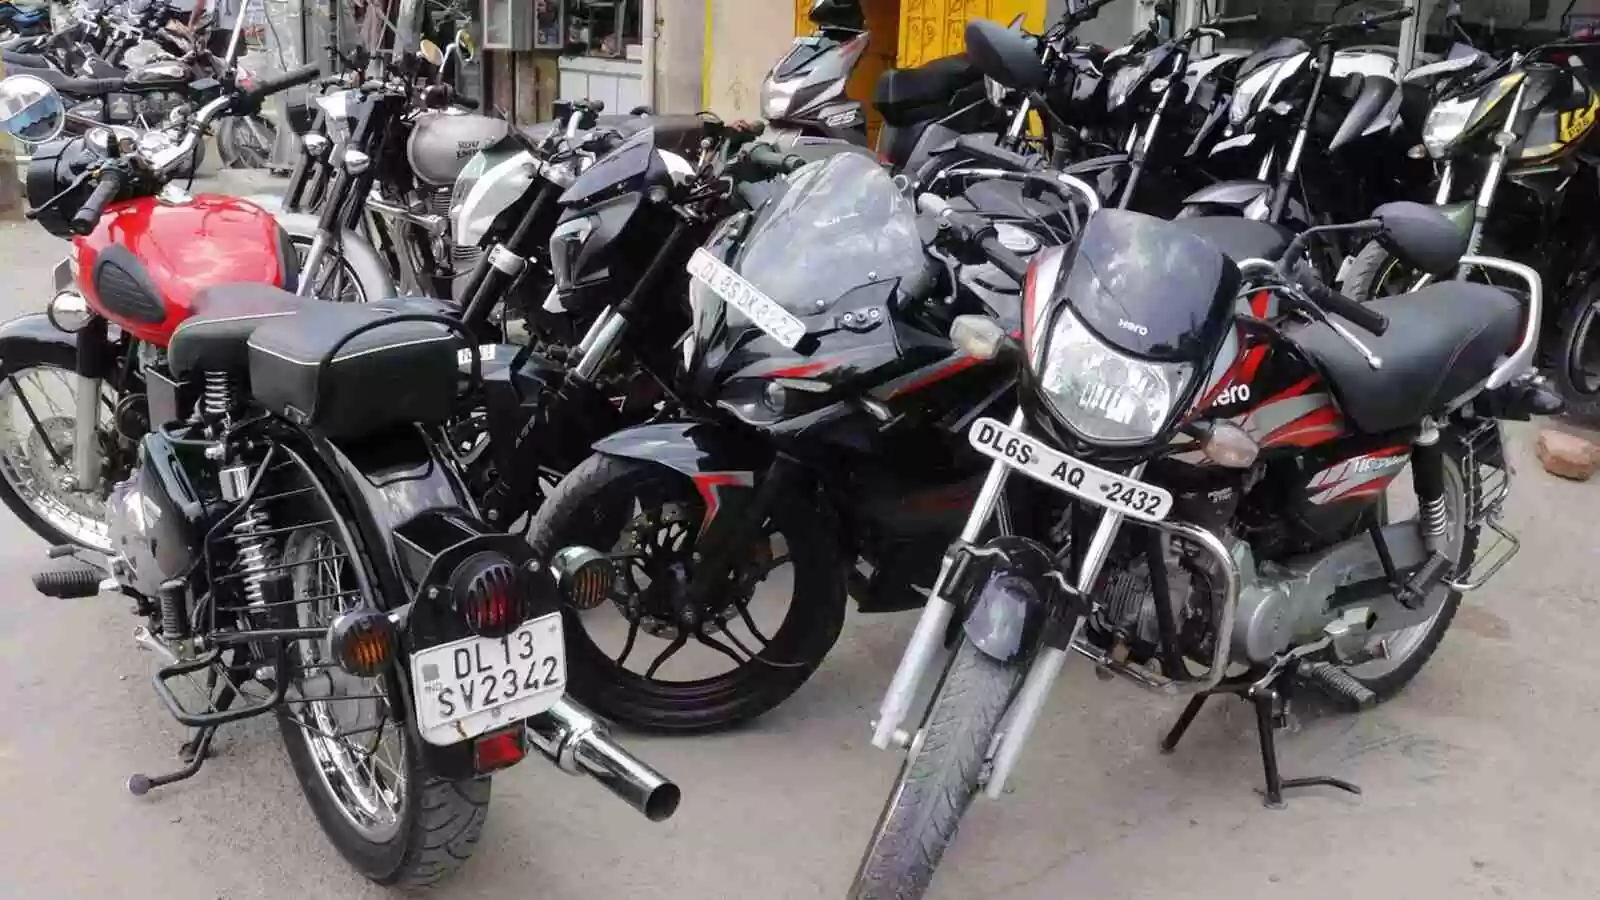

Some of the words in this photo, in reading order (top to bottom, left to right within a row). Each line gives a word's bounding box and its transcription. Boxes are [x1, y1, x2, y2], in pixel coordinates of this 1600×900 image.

[1212, 383, 1250, 407] ero
[978, 424, 1033, 465] DL6S
[1051, 461, 1085, 490] AQ
[1105, 482, 1162, 516] 2432
[454, 643, 493, 679] DL
[501, 630, 533, 664] 13
[438, 656, 558, 717] SV2342
